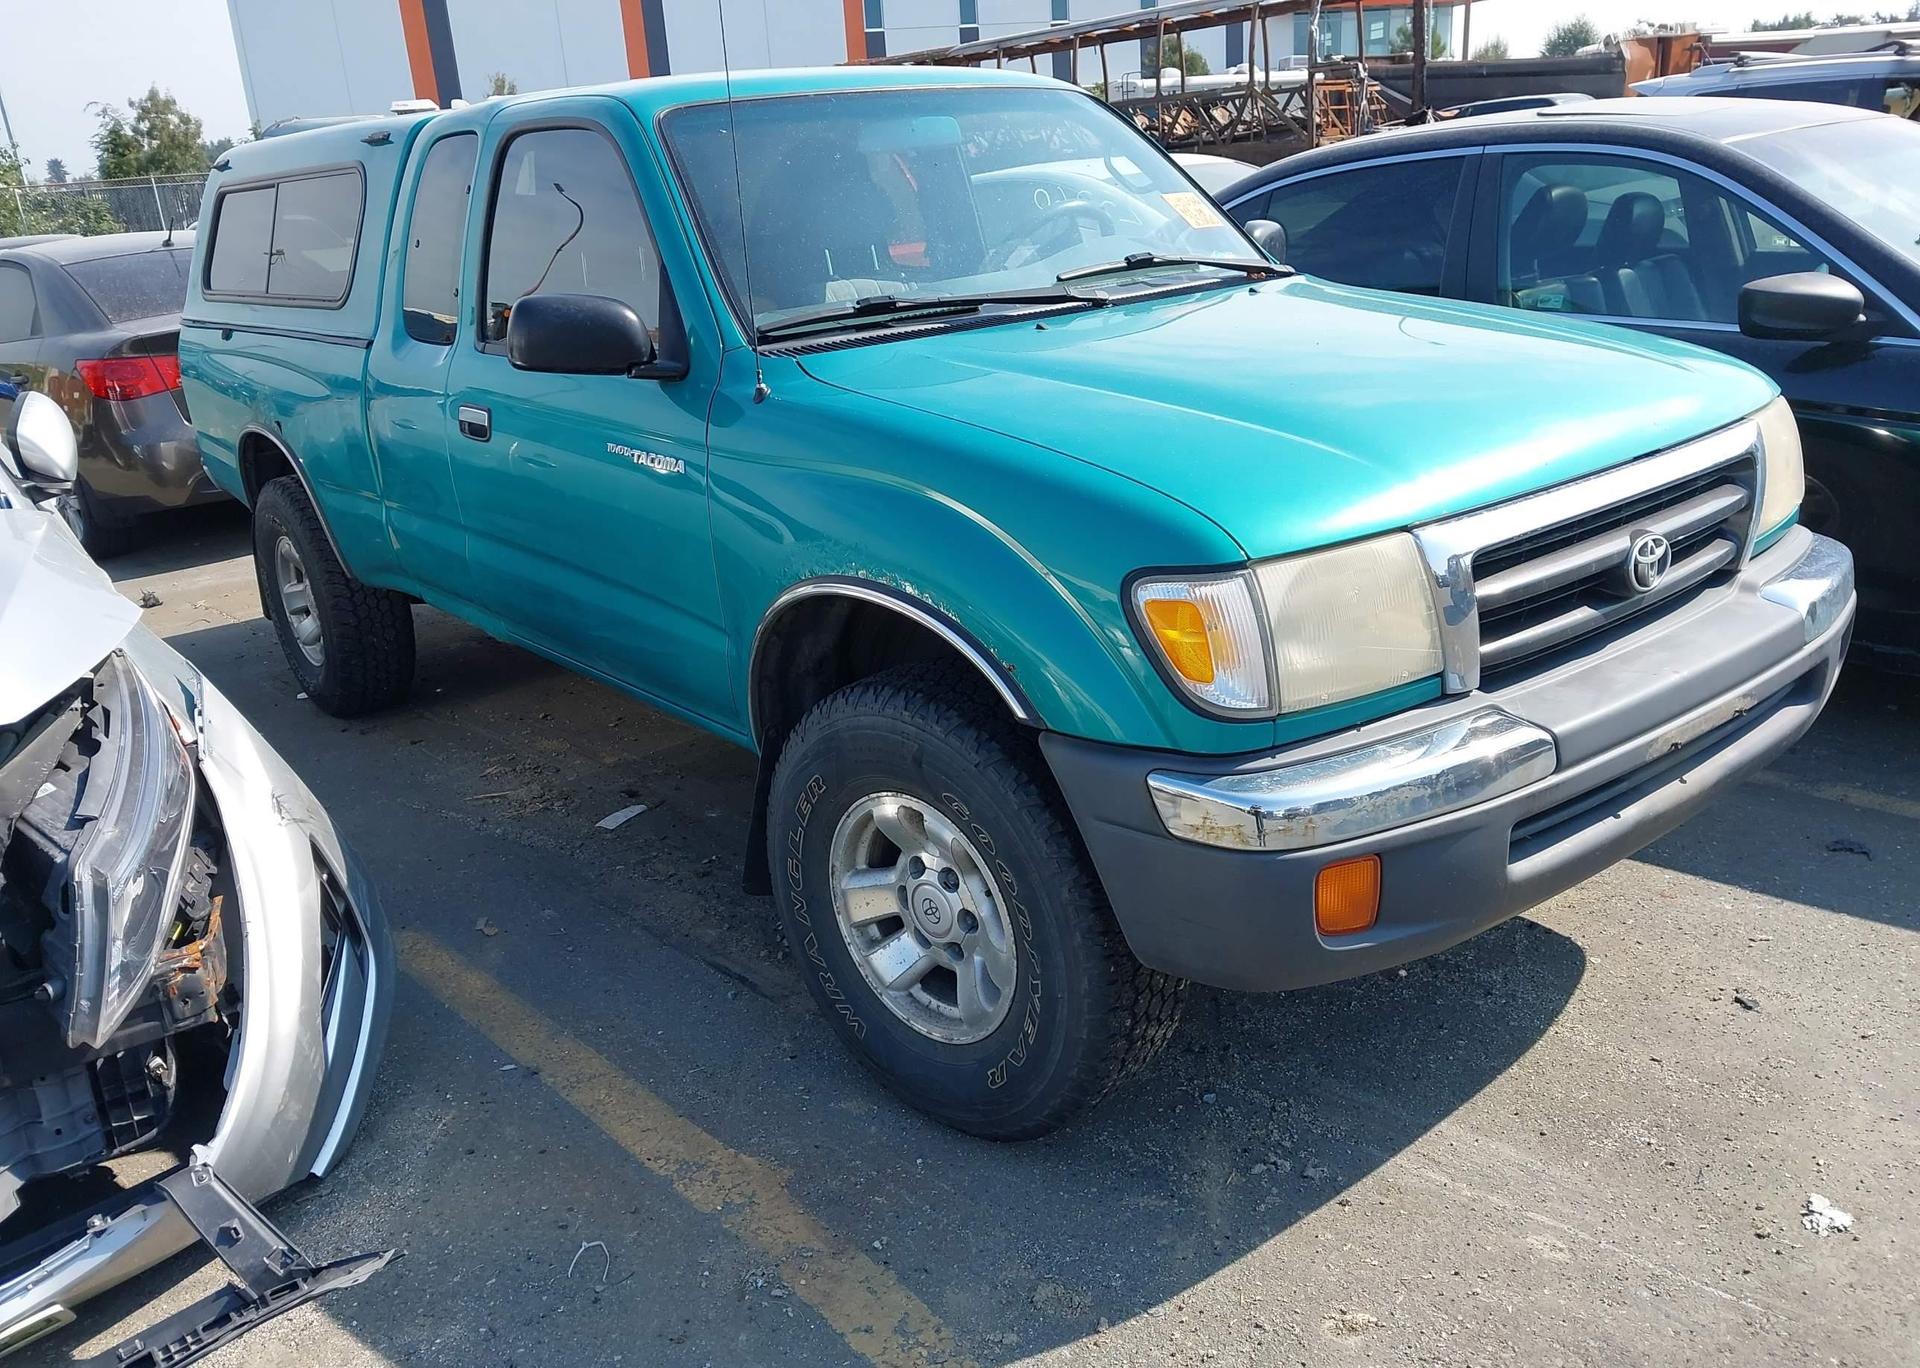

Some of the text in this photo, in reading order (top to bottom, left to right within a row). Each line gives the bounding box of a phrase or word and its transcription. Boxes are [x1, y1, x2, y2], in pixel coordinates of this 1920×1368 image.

[631, 450, 685, 474] TACOMA
[786, 773, 868, 1040] WRANGLER
[941, 792, 1041, 1090] GOODYEAR
